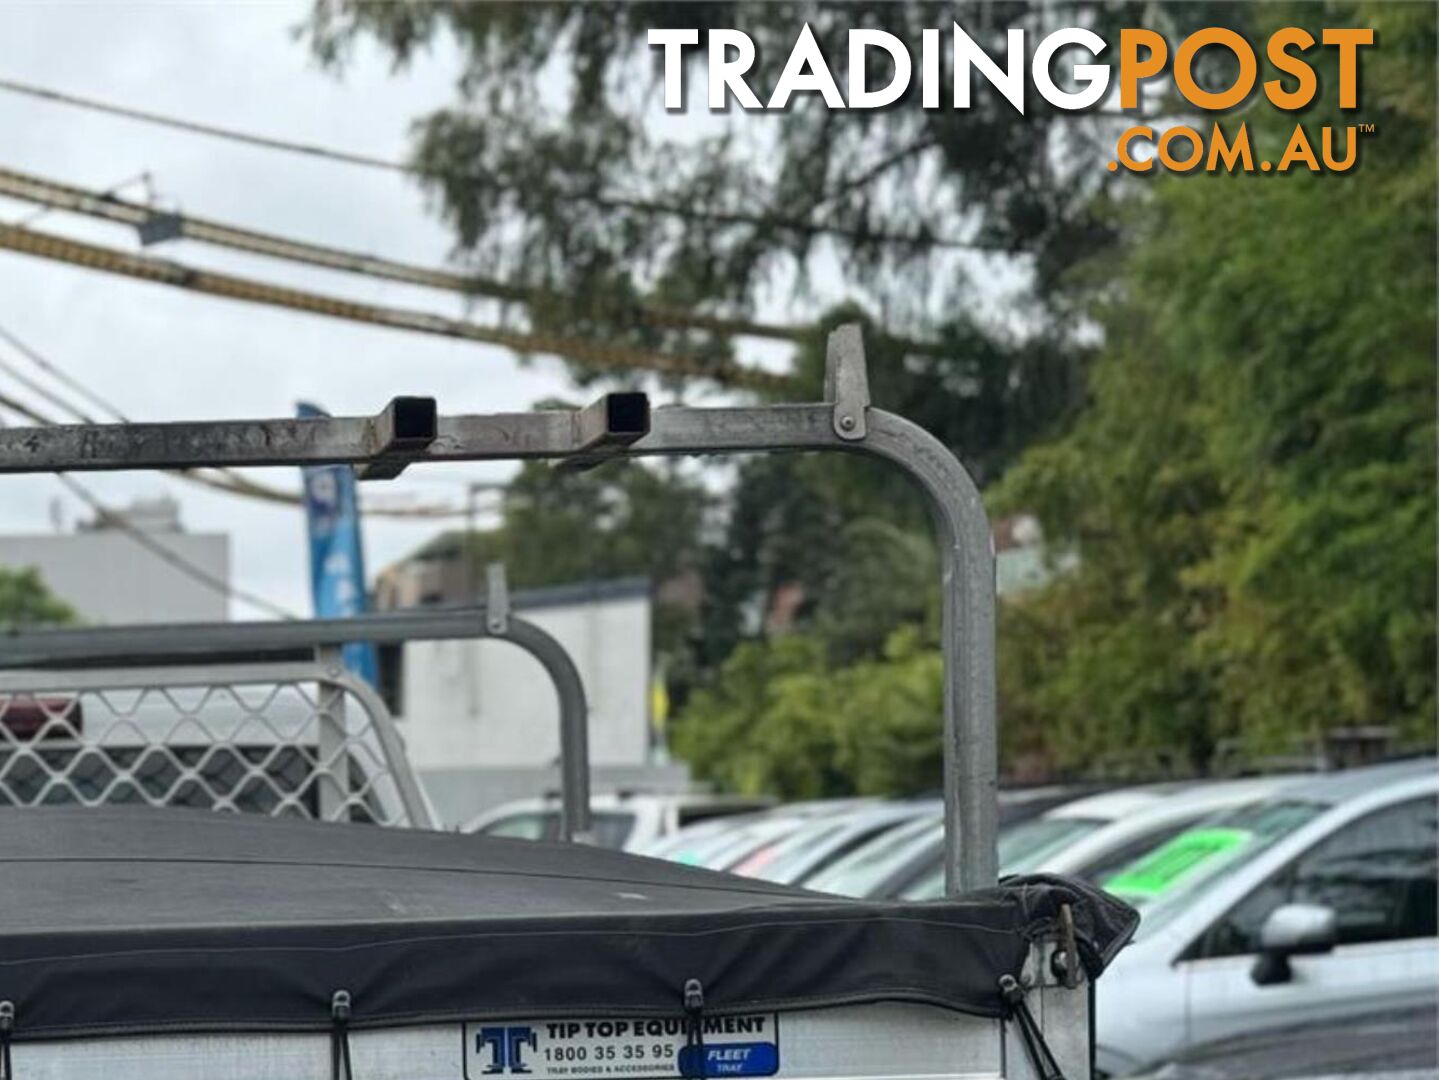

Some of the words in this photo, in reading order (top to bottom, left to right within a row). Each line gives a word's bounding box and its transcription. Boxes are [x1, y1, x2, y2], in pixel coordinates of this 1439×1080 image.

[546, 1023, 580, 1039] TIP
[585, 1021, 629, 1038] TOP
[634, 1016, 766, 1037] EQUIMENT
[544, 1047, 587, 1062] 1800
[594, 1046, 615, 1061] 35
[623, 1046, 645, 1060] 35
[652, 1044, 674, 1059] 95
[707, 1048, 751, 1061] FLEET
